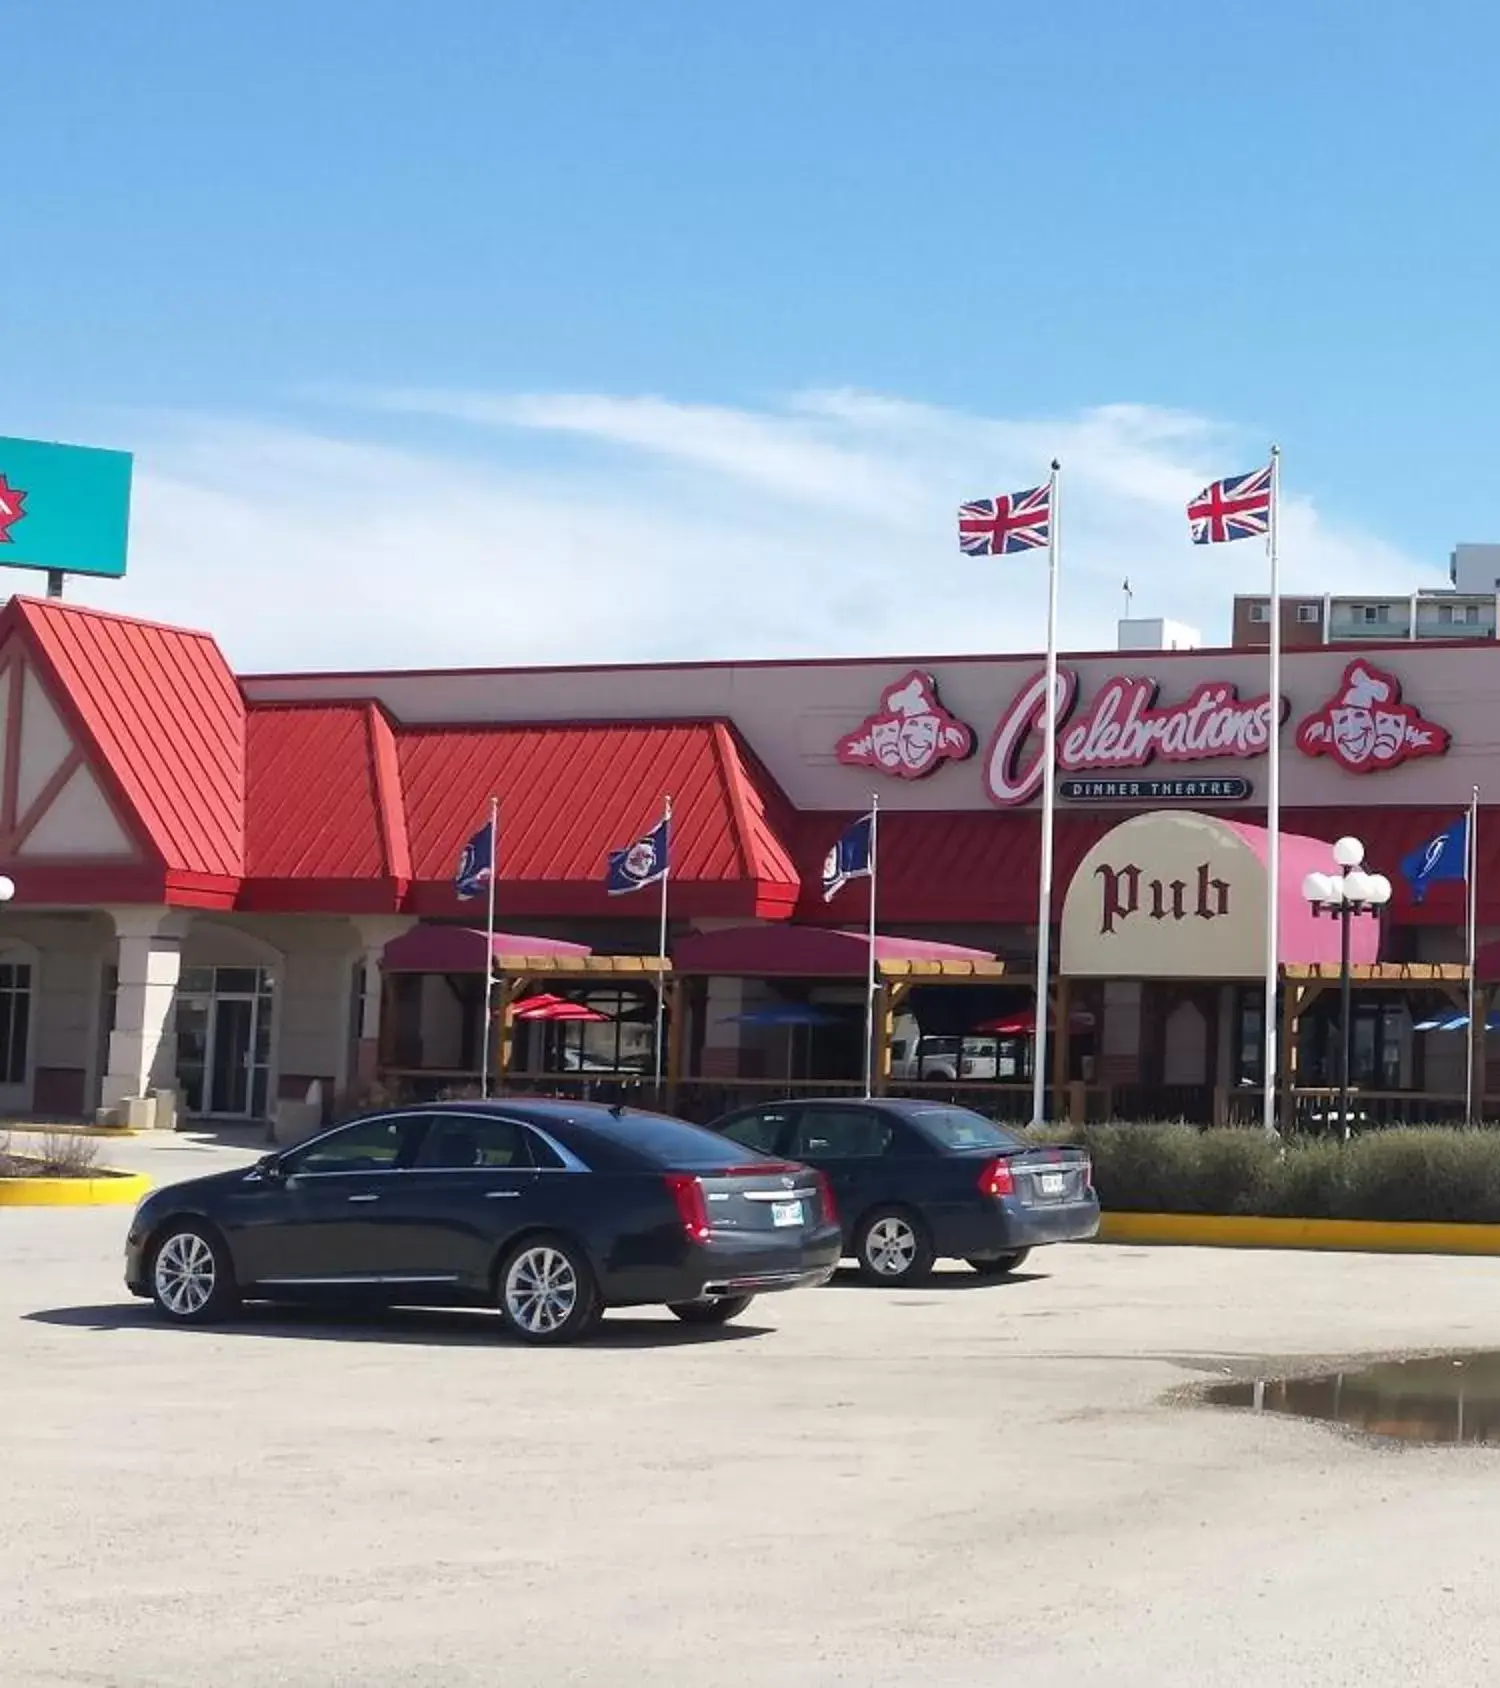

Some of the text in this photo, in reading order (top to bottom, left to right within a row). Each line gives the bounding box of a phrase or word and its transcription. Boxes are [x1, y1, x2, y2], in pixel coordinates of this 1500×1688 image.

[987, 671, 1274, 799] Celebrations
[1072, 781, 1234, 796] DINNER THEATRE
[1093, 861, 1231, 935] Pub
